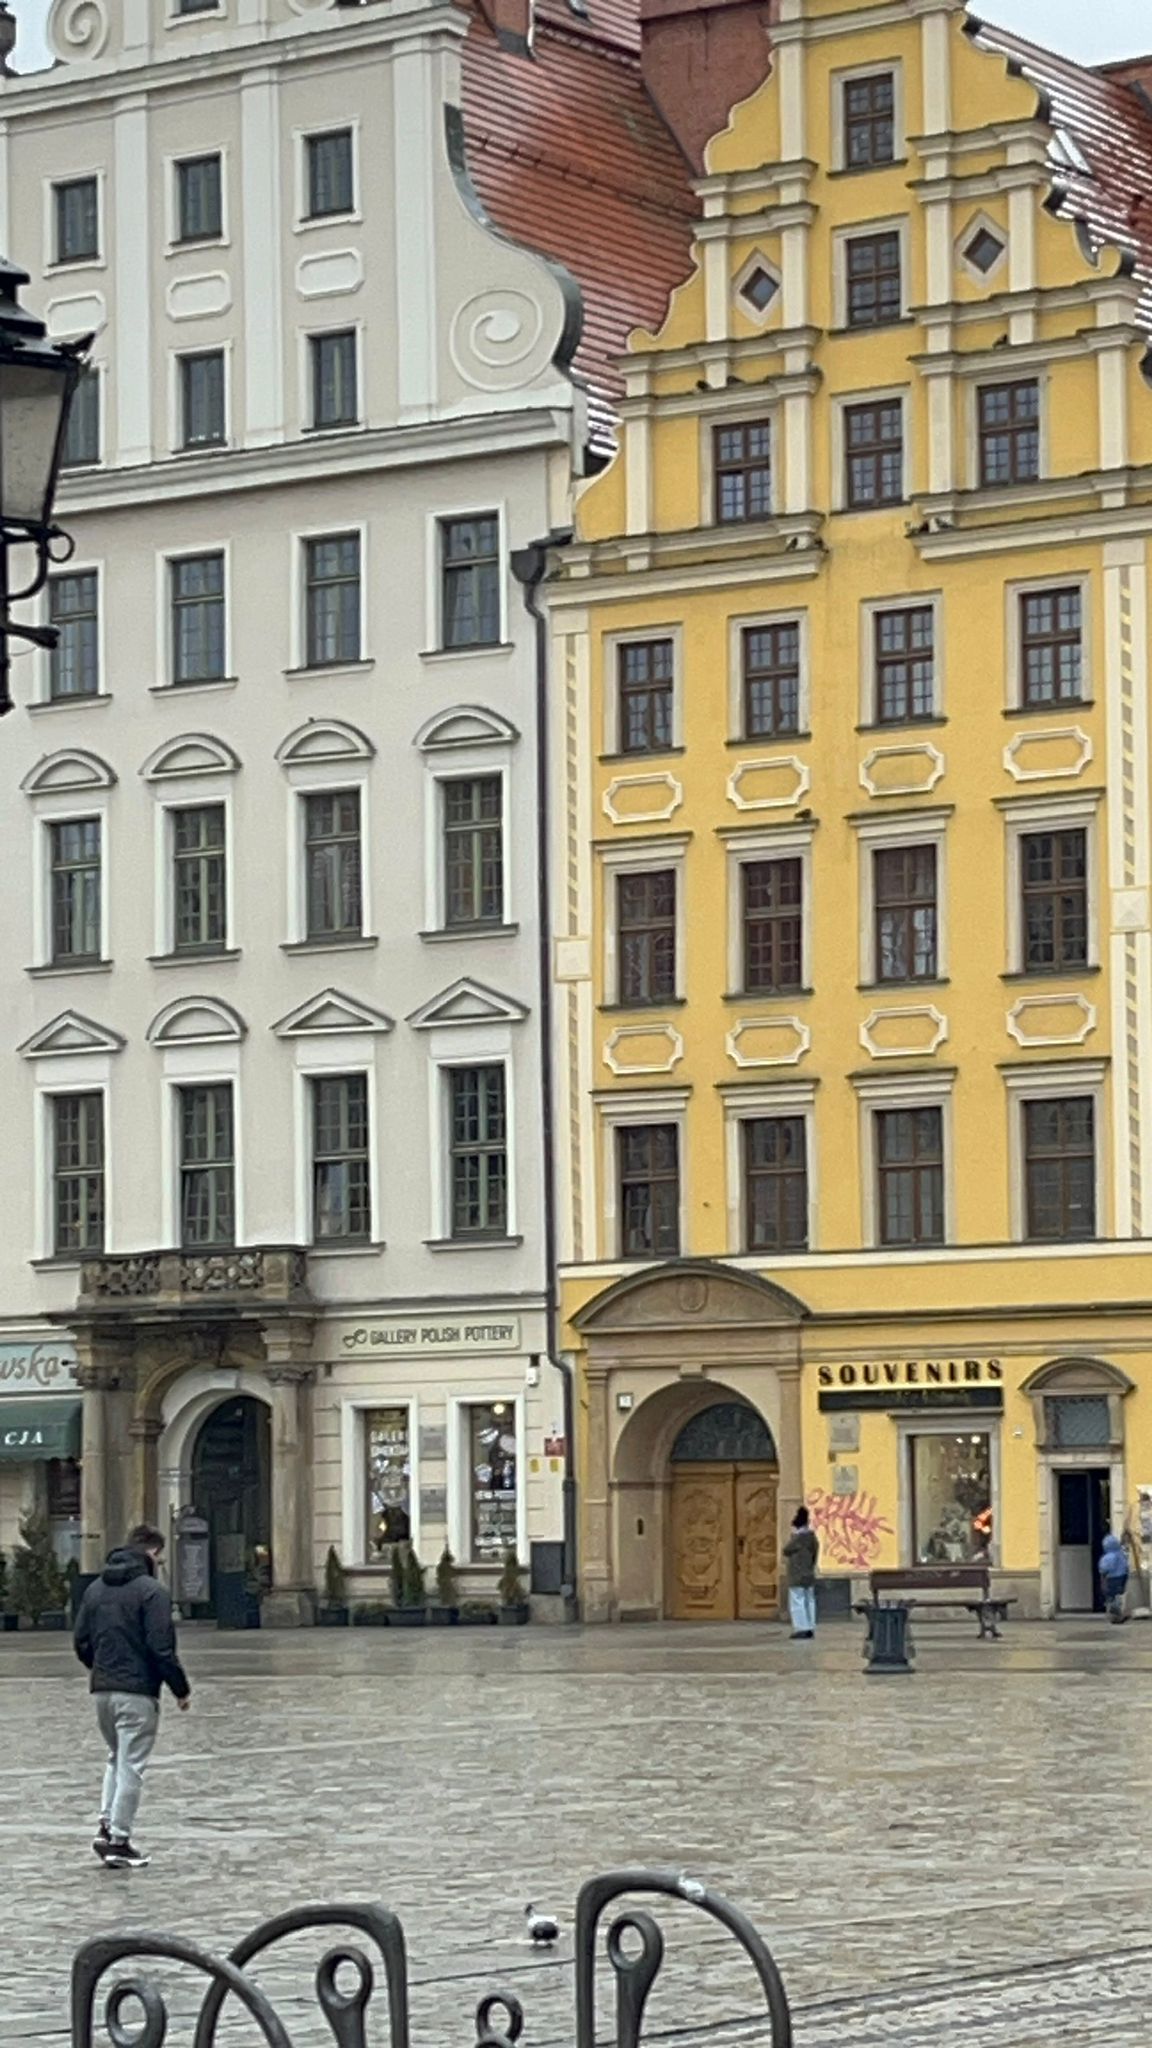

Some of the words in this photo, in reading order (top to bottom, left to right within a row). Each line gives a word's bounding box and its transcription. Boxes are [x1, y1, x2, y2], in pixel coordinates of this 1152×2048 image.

[370, 1329, 417, 1345] GALLERY
[421, 1327, 460, 1343] POLISH
[464, 1325, 514, 1341] POTTERY
[818, 1359, 1003, 1385] SOUVENIRS
